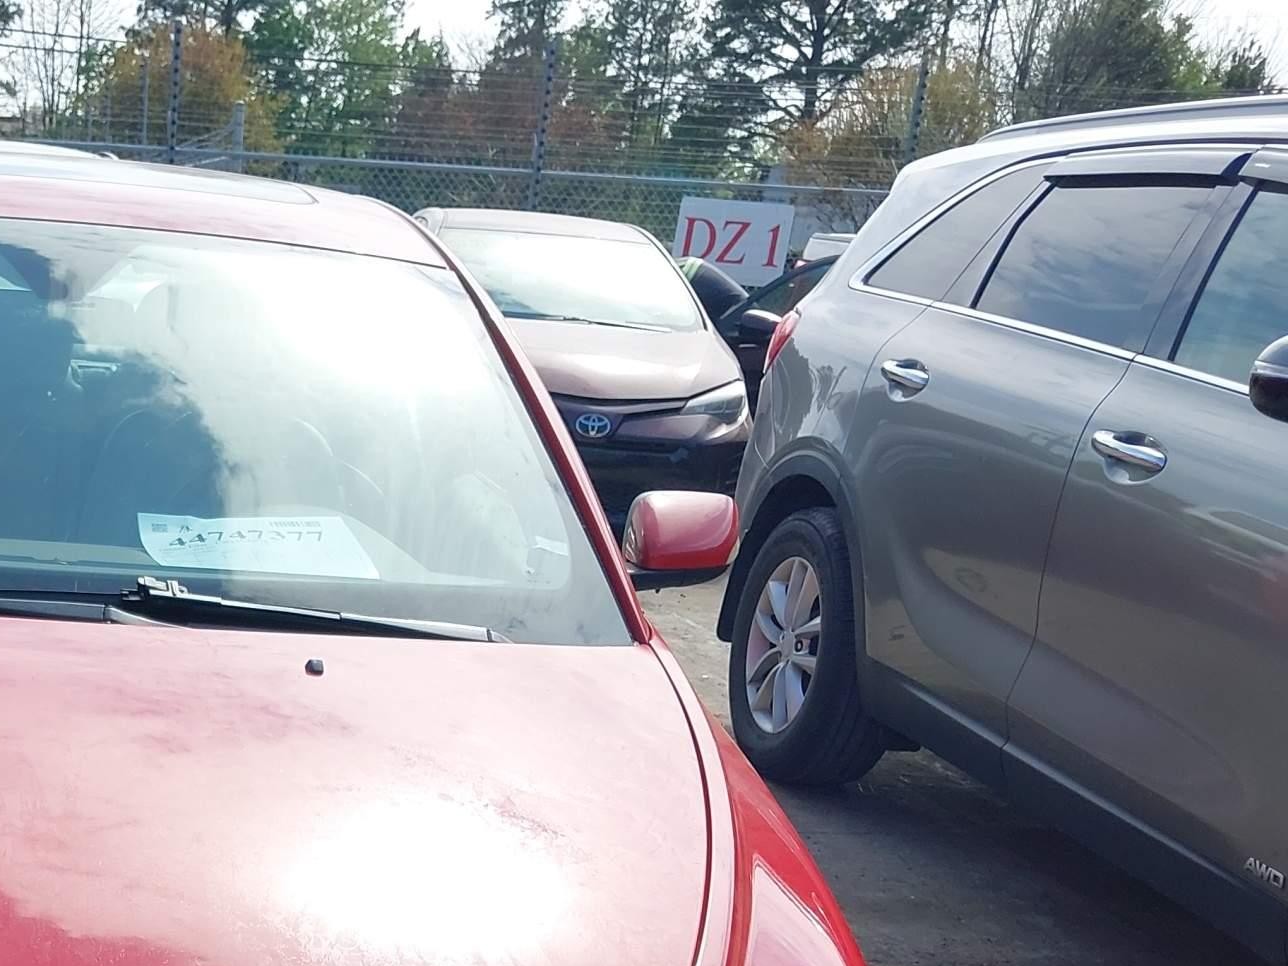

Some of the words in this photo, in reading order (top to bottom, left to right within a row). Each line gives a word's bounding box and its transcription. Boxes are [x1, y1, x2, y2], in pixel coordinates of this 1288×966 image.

[681, 216, 752, 265] DZ
[761, 223, 781, 268] 1
[168, 529, 323, 547] 44747377
[1243, 856, 1285, 889] AWD
